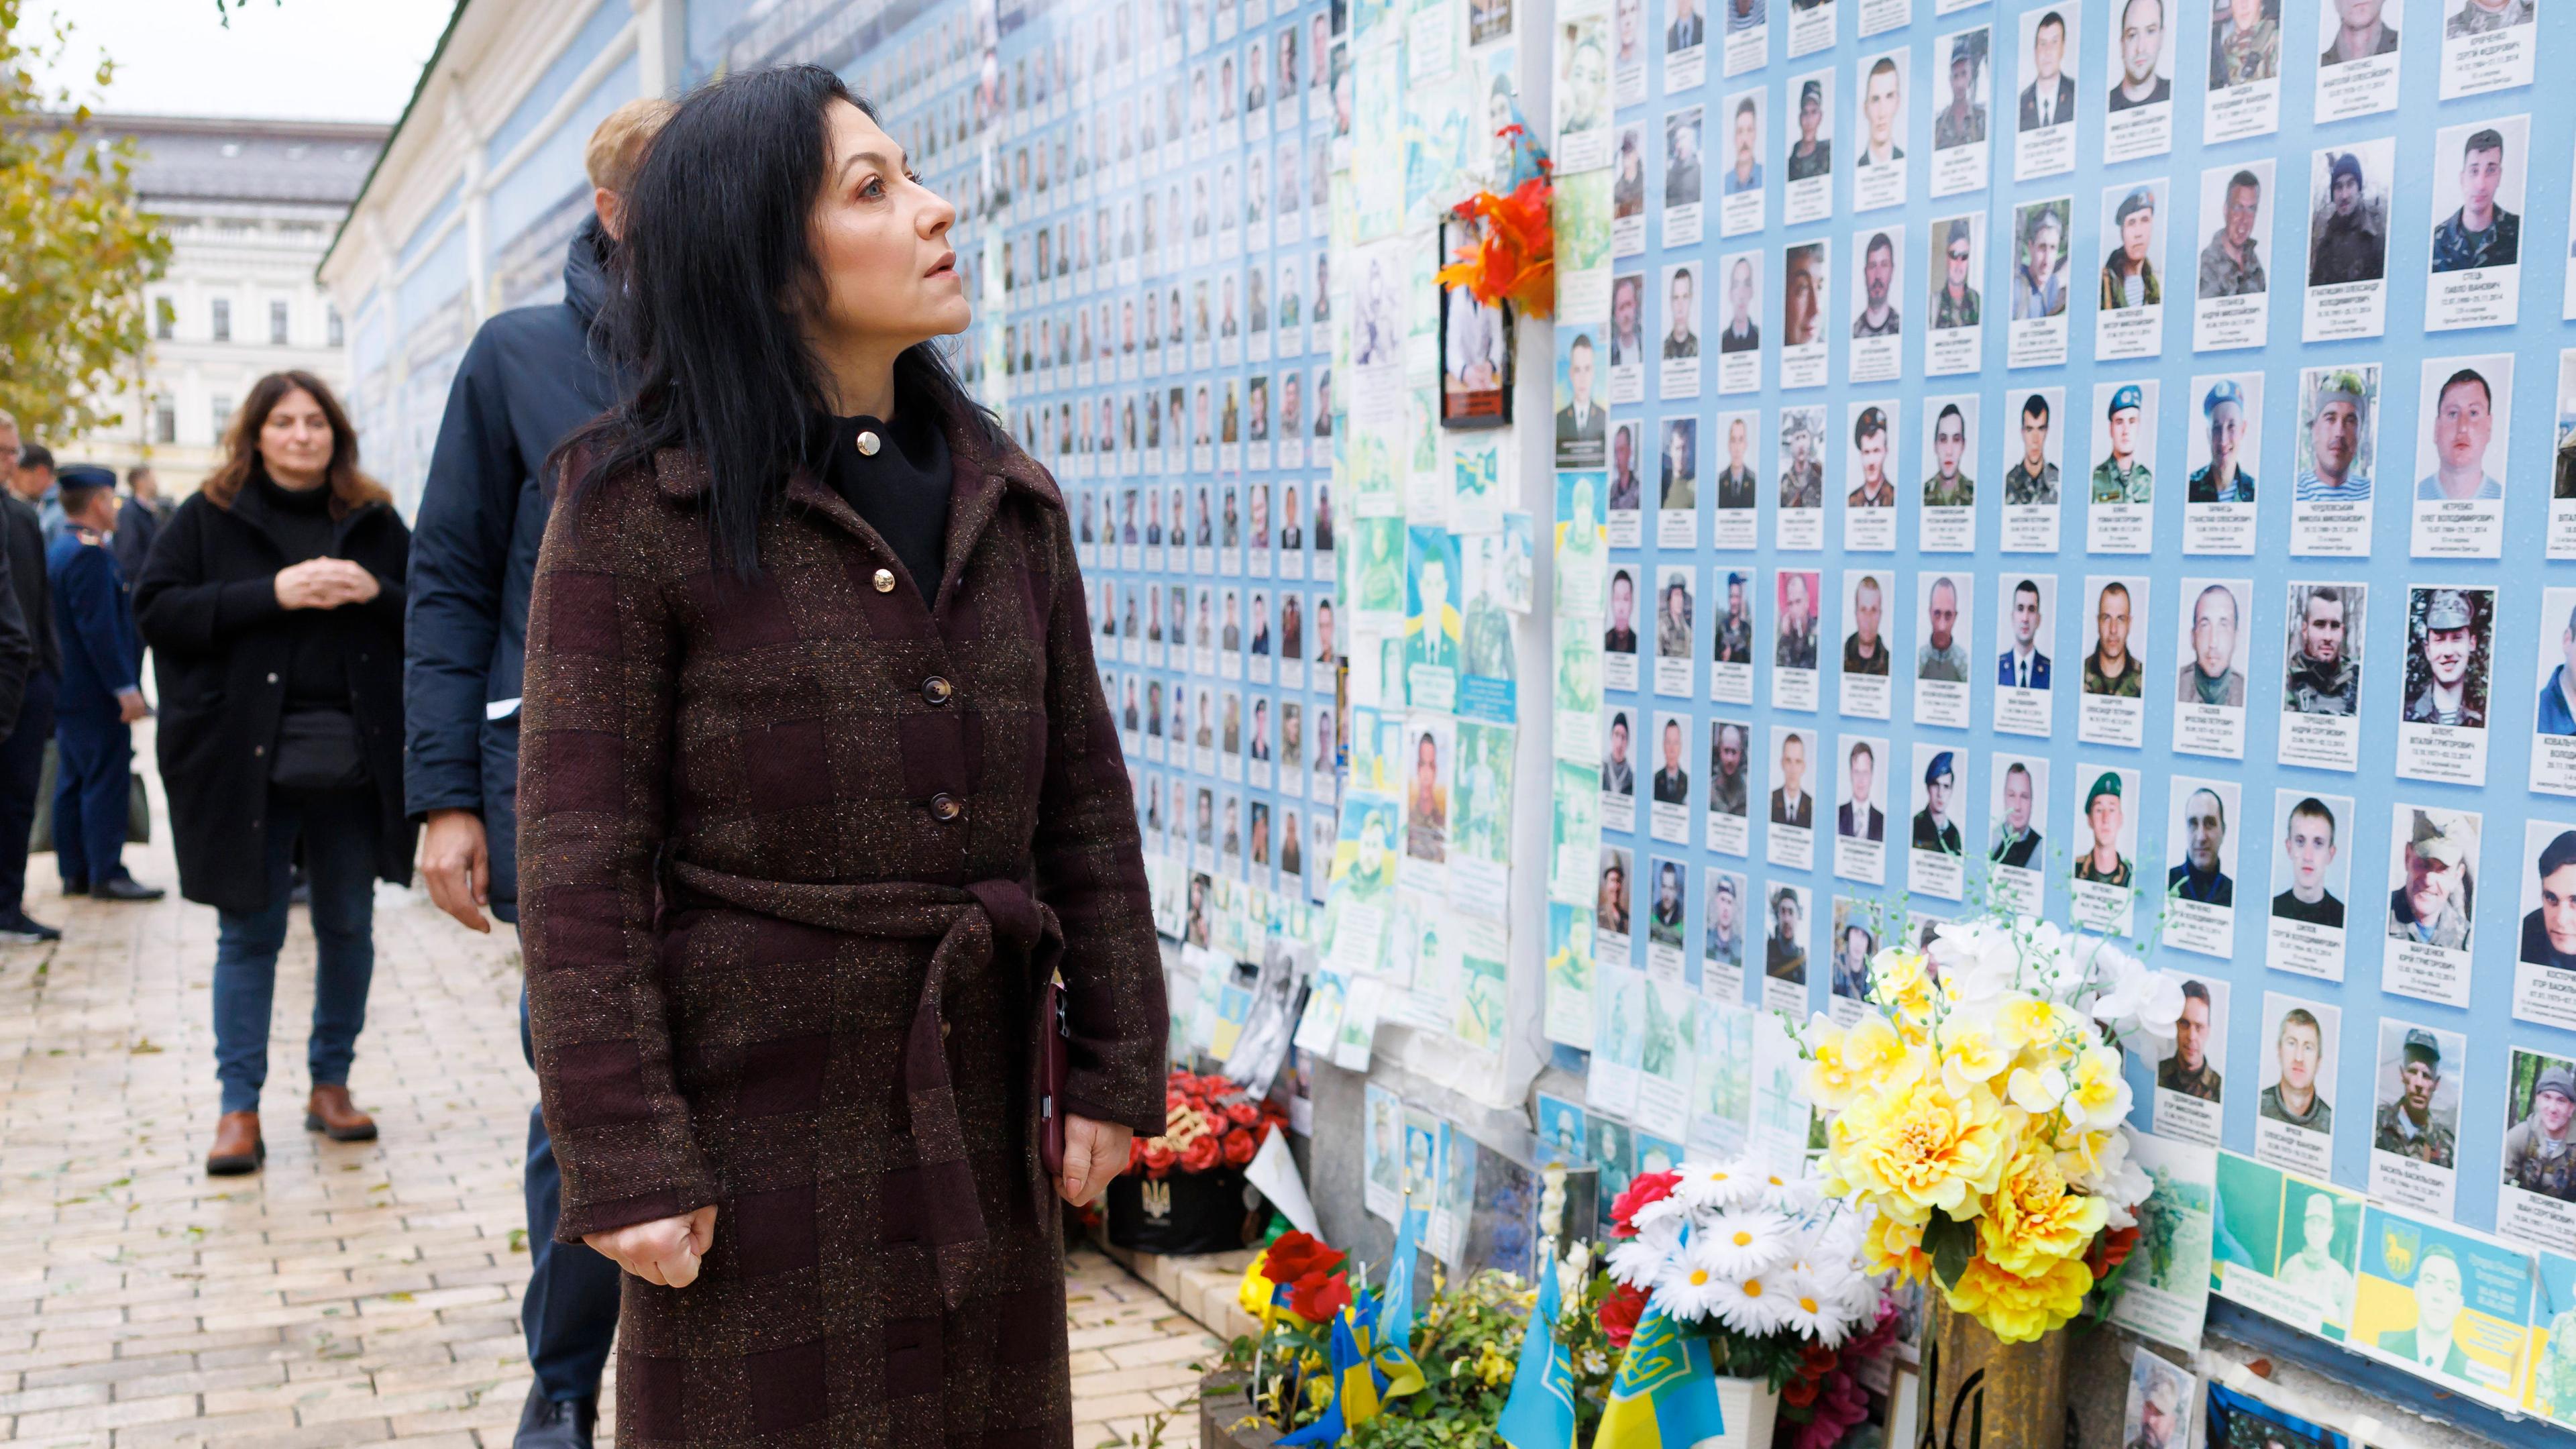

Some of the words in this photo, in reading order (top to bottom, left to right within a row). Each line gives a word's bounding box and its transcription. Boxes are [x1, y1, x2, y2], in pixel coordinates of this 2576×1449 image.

[2445, 284, 2466, 294] ПАВЛО
[2468, 281, 2501, 292] ІВАНОВИЧ
[2420, 514, 2436, 523] ОЛЕГ
[2438, 515, 2495, 523] ВОЛОДИМИРОВИЧ
[2410, 737, 2432, 746] ВІТАЛІЙ
[2434, 738, 2475, 749] ГРИГОРОВИЧ
[2416, 957, 2455, 971] ГРИГОРОВИЧ
[2404, 1171, 2445, 1187] ВАСИЛЬОВИЧ
